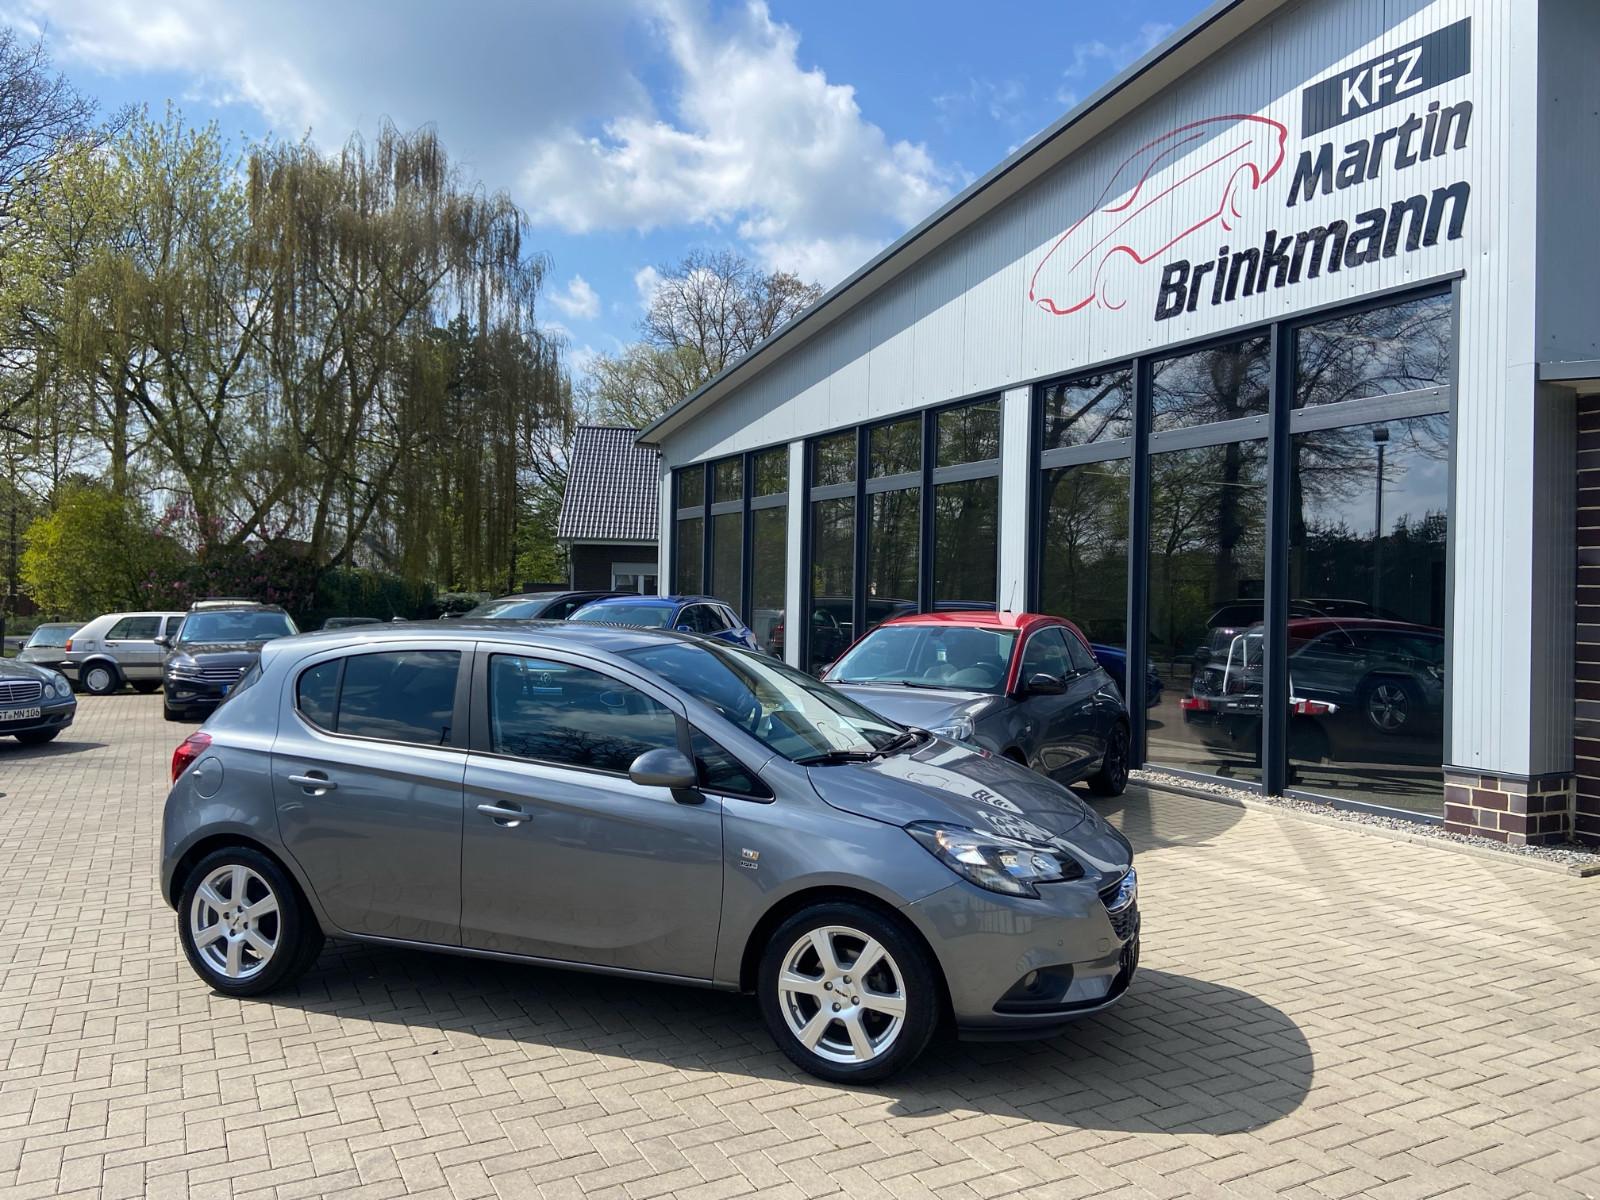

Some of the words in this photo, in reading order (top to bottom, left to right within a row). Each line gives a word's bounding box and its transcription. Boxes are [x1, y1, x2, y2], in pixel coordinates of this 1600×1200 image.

[1341, 45, 1423, 117] KFZ
[1286, 100, 1473, 207] Martin
[1154, 181, 1471, 321] Brinkmann
